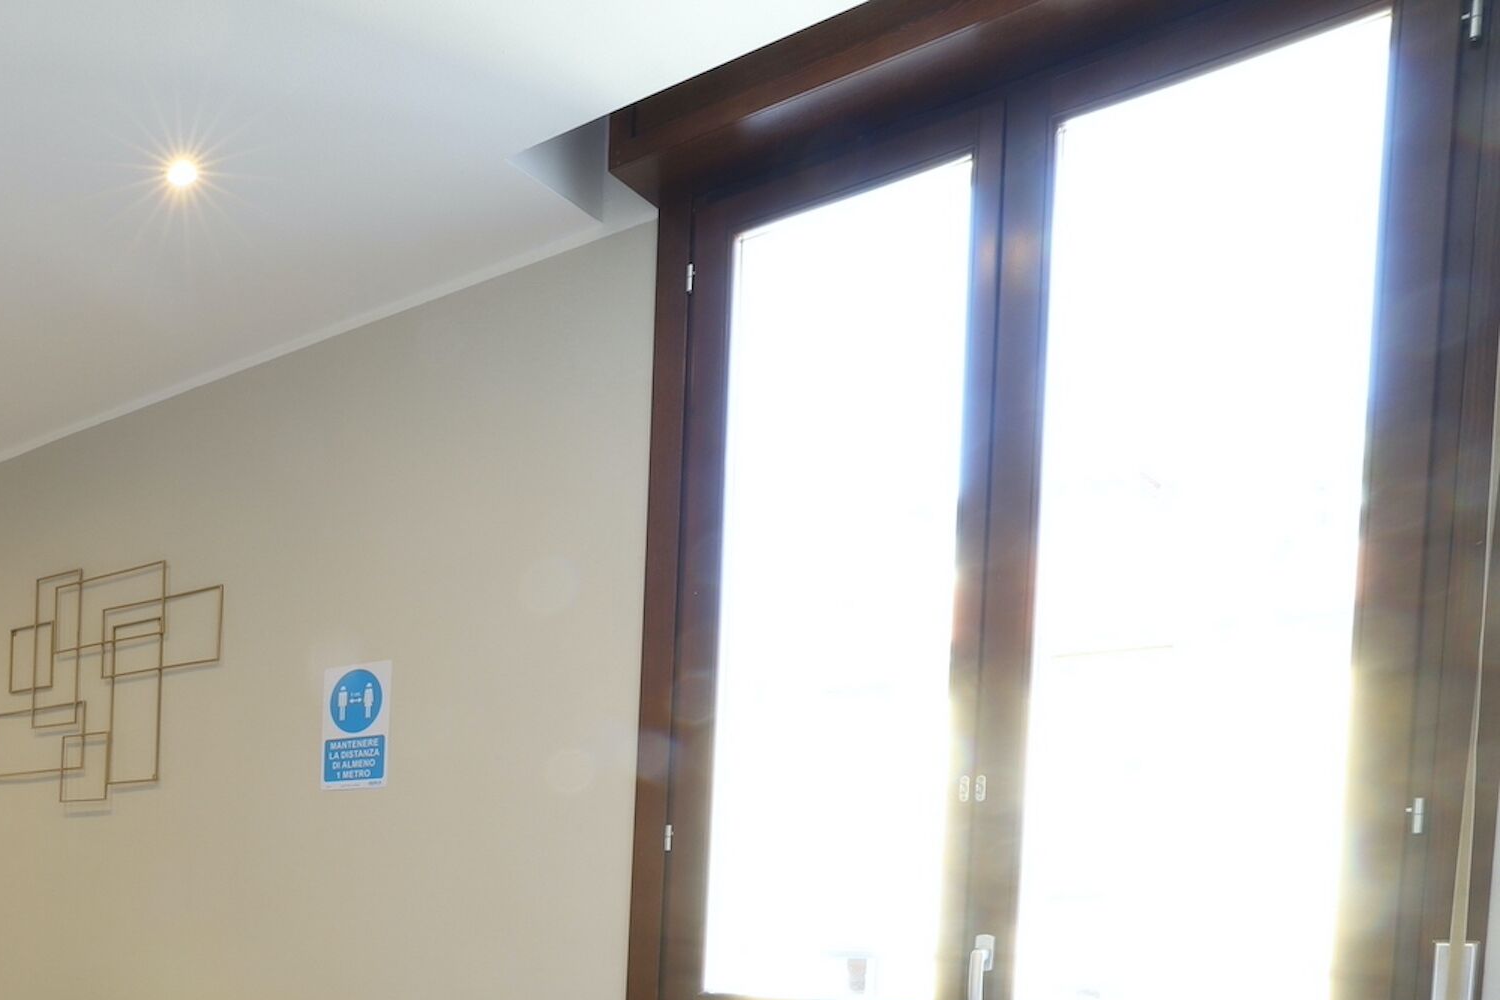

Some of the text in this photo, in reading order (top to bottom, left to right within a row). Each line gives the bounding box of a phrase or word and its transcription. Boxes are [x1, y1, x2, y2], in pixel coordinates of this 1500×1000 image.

[329, 738, 379, 750] MANTENERE
[328, 748, 380, 760] LA DISTANZA
[332, 758, 376, 770] DI ALMENO
[342, 769, 372, 779] METRO
